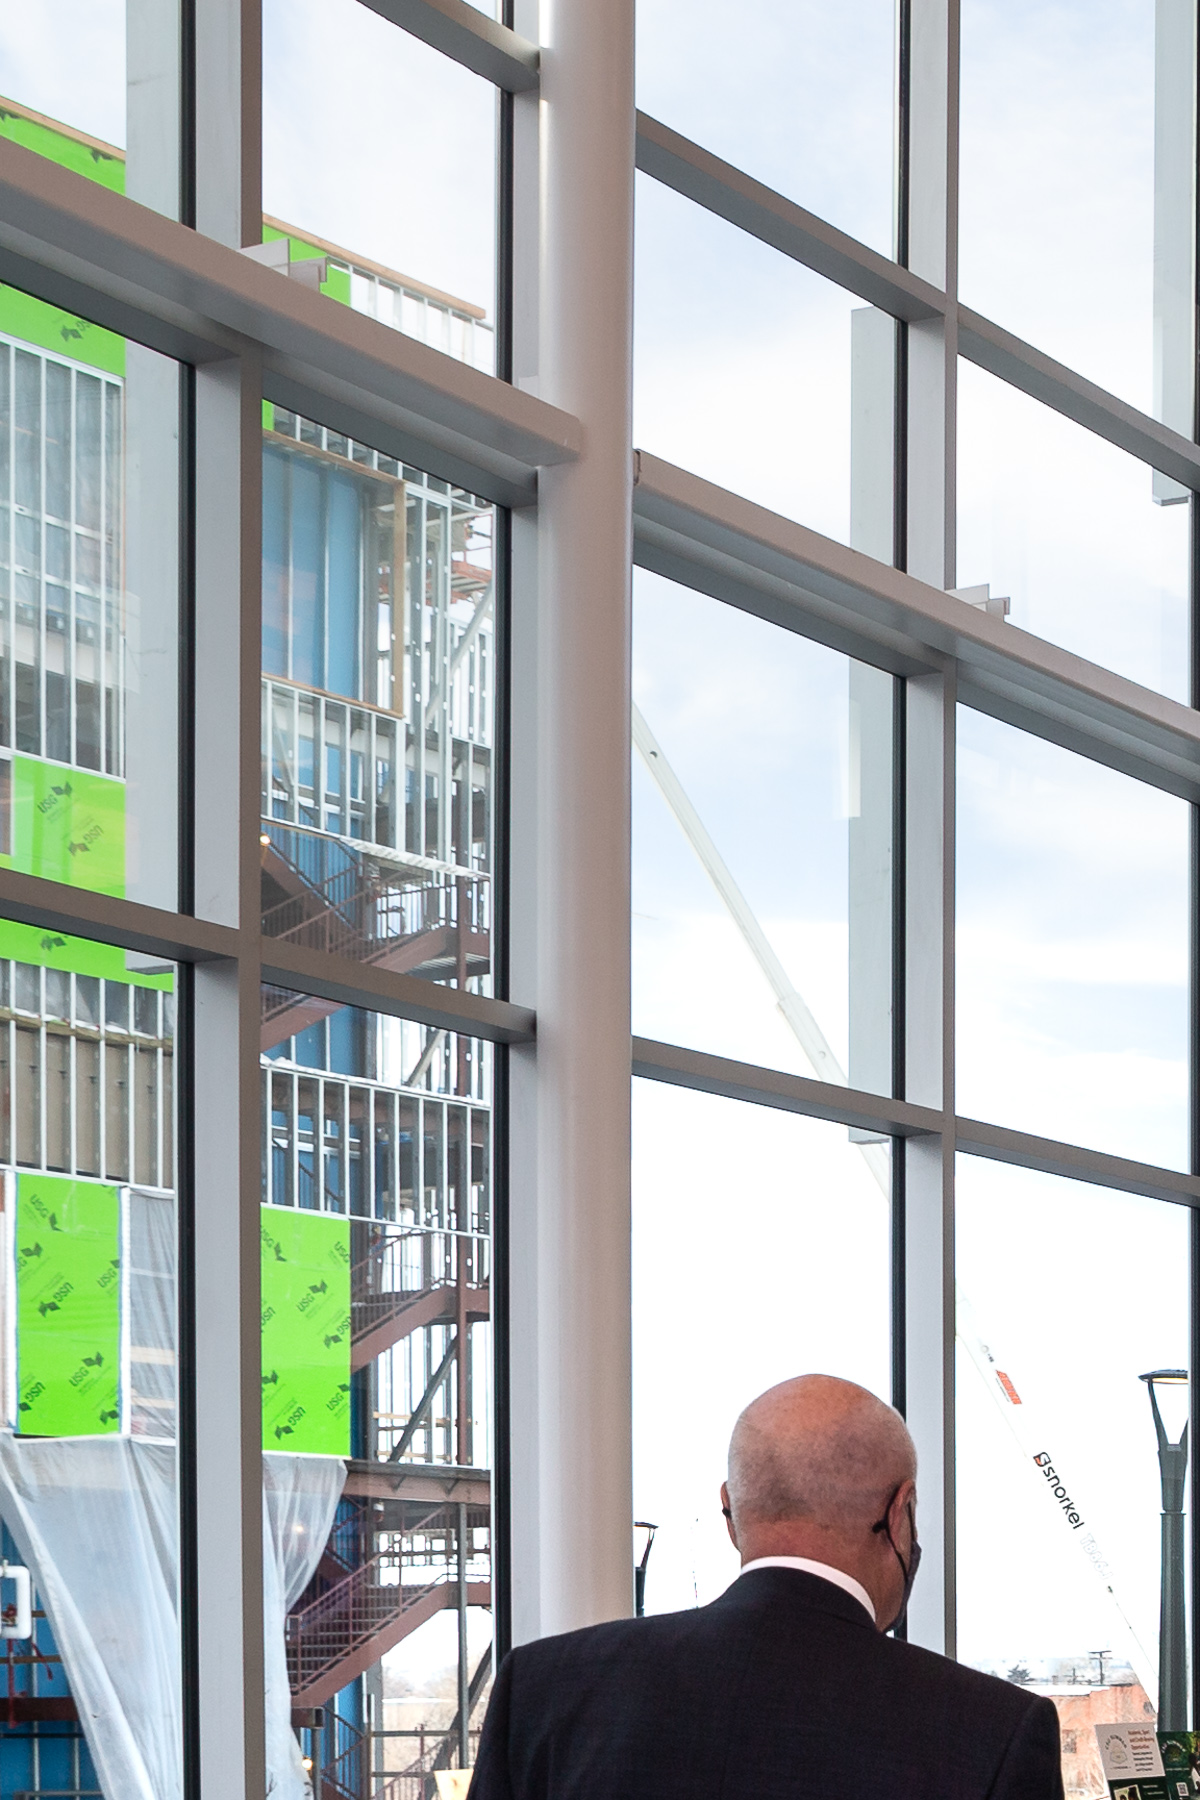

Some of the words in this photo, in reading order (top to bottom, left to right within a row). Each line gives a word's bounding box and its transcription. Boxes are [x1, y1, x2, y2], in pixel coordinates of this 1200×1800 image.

[96, 1268, 118, 1289] USG
[53, 1280, 75, 1303] USG
[296, 1292, 315, 1313] USG
[68, 1366, 90, 1387] USG
[24, 1381, 46, 1403] USG
[325, 1391, 345, 1412] USG
[287, 1405, 307, 1427] USG
[1043, 1465, 1085, 1530] snorkel
